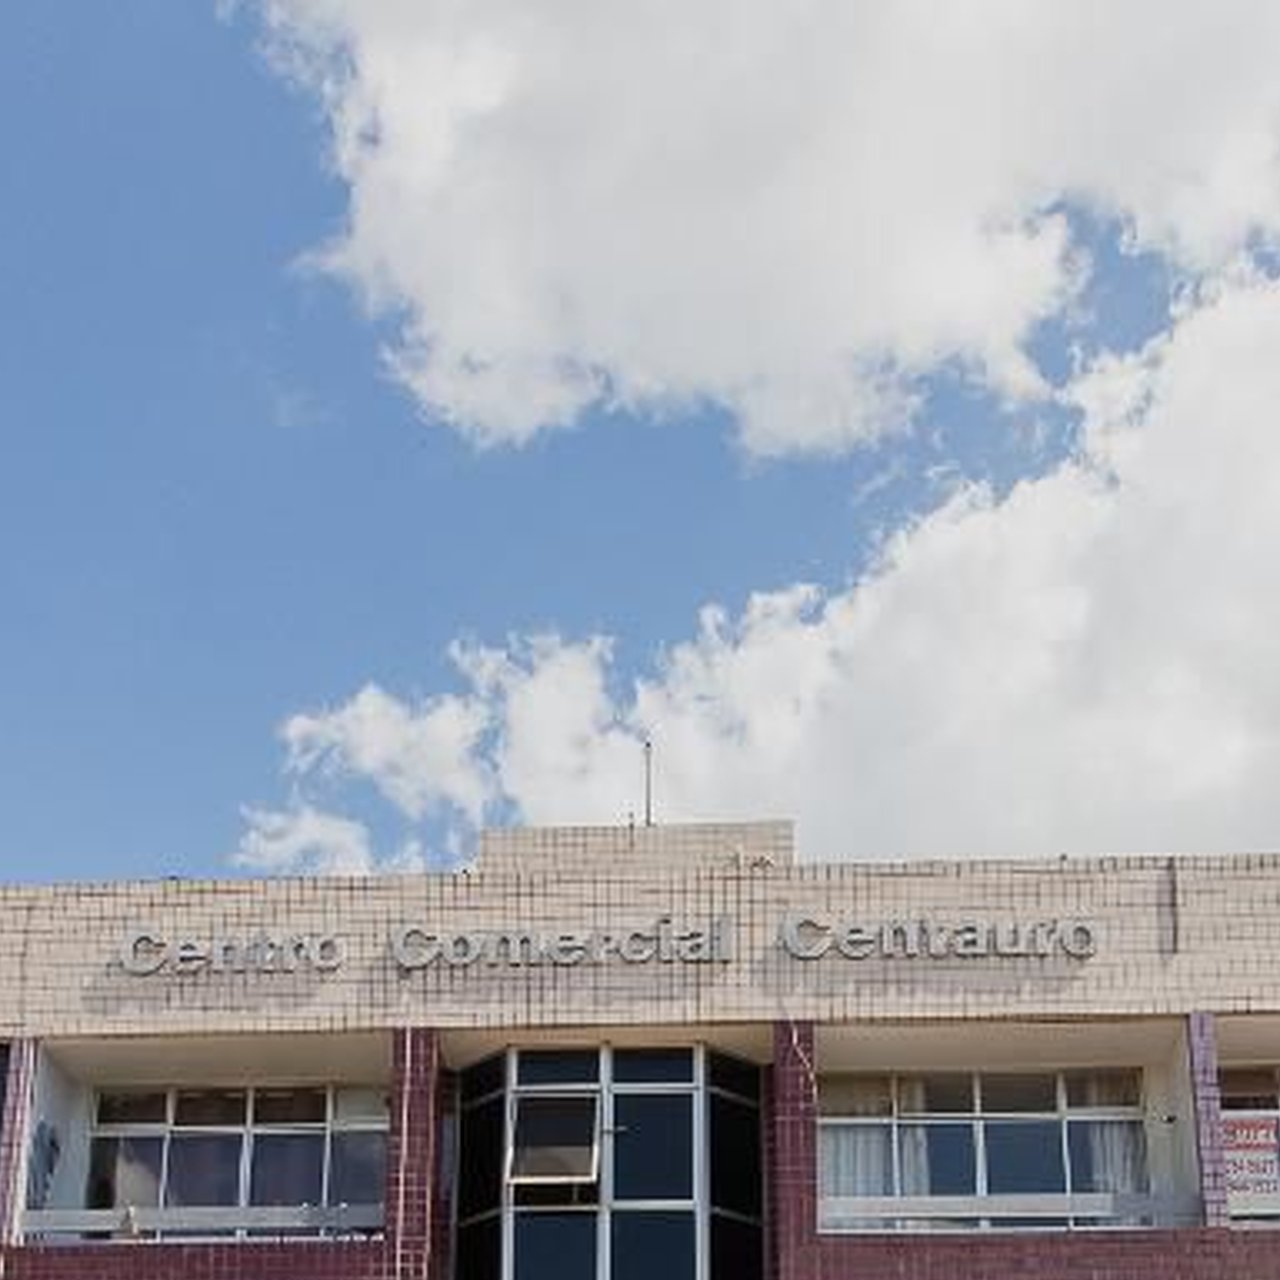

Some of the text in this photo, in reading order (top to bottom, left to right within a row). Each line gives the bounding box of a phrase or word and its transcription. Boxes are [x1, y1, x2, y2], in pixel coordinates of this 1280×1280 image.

[121, 909, 1098, 976] Centro Comercial Centauro
